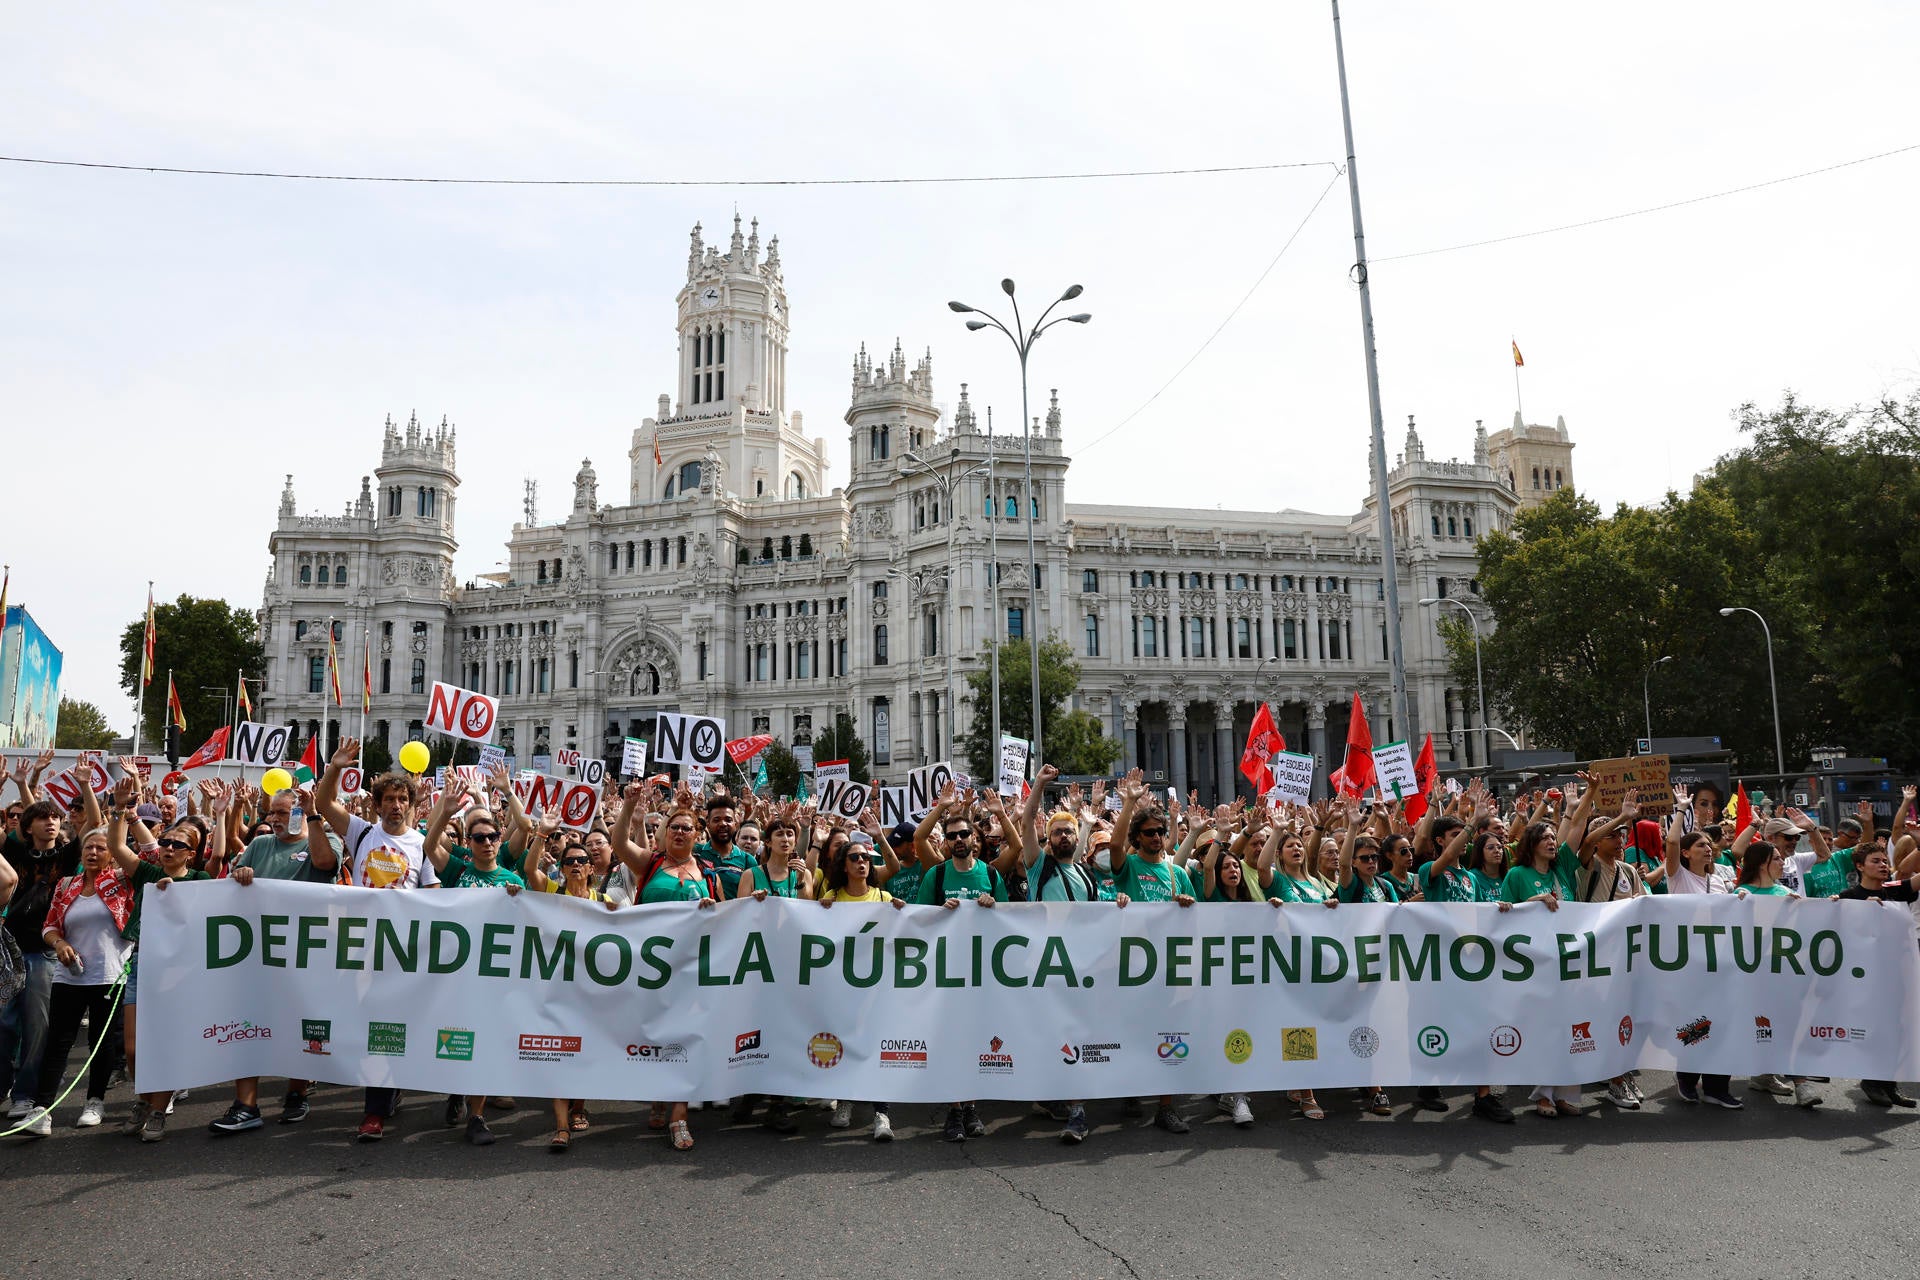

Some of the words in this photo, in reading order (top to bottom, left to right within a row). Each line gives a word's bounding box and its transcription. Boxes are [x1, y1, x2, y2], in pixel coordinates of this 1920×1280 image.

[427, 684, 494, 738] NO
[236, 724, 287, 765] NO
[657, 715, 722, 764] NO
[1374, 748, 1399, 758] Maestros
[817, 770, 822, 778] La
[822, 767, 848, 777] educación,
[1280, 768, 1310, 784] PÚBLICAS
[525, 775, 597, 827] NO
[819, 779, 866, 817] NO
[104, 886, 119, 896] CGT
[207, 915, 673, 989] DEFENDEMOS
[699, 932, 774, 986] LA
[799, 921, 1095, 988] PÚBLICA.
[1119, 934, 1534, 987] DEFENDEMOS
[1558, 930, 1612, 981] EL
[1626, 924, 1866, 978] FUTURO.
[1756, 1029, 1772, 1038] STEM
[1810, 1026, 1834, 1038] UGT
[522, 1036, 562, 1048] CCOO
[738, 1036, 757, 1048] CNT
[880, 1040, 927, 1051] CONFAPA
[1570, 1040, 1594, 1048] JUVENTUD
[626, 1044, 662, 1057] CGT
[1570, 1046, 1596, 1054] COMUNISTA
[728, 1055, 746, 1064] Sección
[746, 1052, 770, 1060] Sindical
[979, 1054, 1012, 1062] CONTRA
